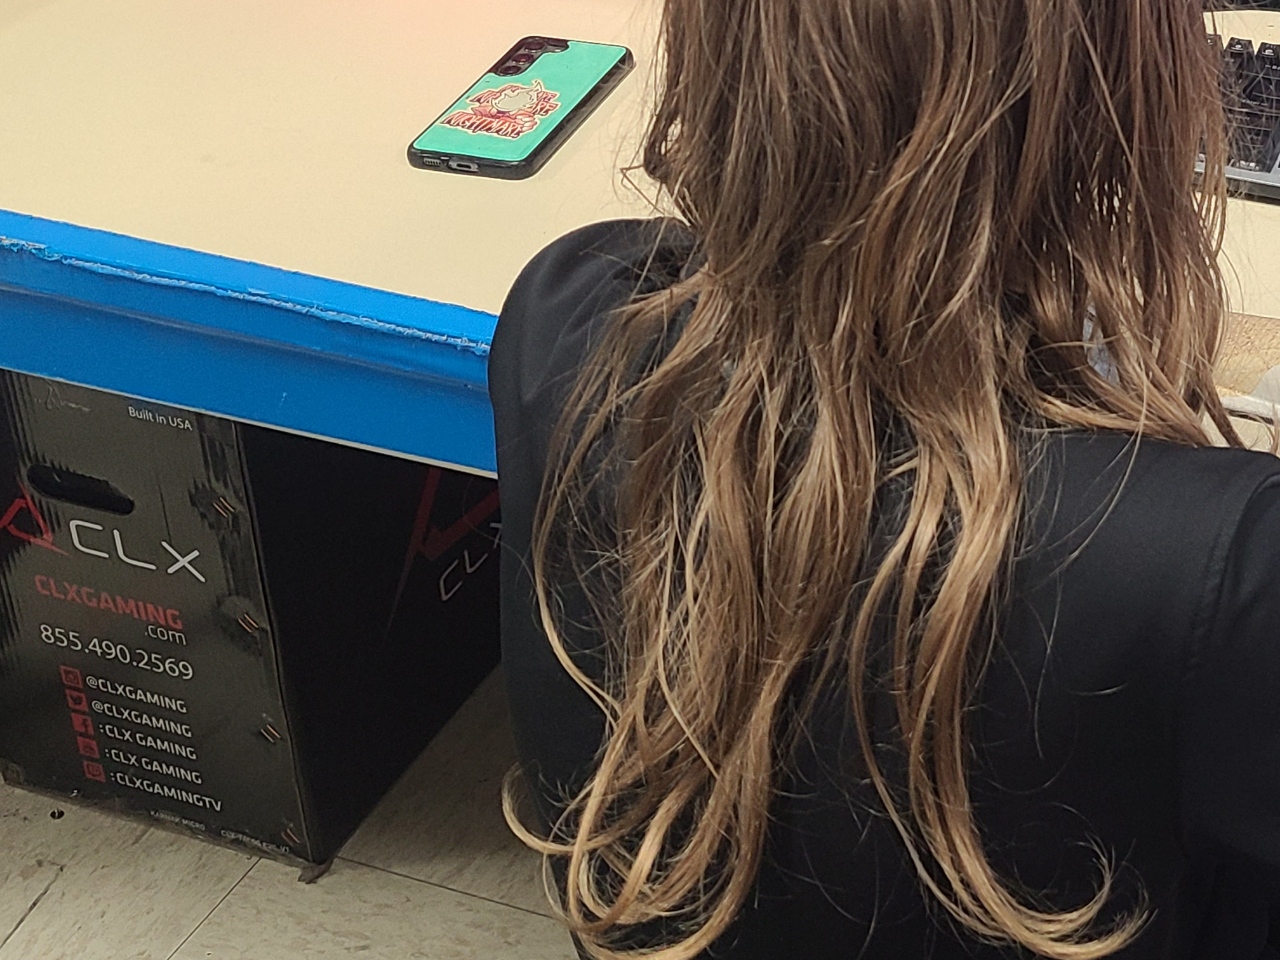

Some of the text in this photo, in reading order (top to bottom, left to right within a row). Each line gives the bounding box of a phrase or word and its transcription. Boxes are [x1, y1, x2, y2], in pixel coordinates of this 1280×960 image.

[442, 111, 523, 138] NIGHTMARE
[128, 406, 192, 431] Built in USA
[69, 519, 206, 583] CLX
[34, 575, 183, 630] CLXGAMING
[40, 624, 193, 680] 855.490.2569
[145, 625, 187, 646] .com
[86, 675, 187, 713] @CLXGAMING
[91, 700, 192, 738] @CLXGAMING
[135, 733, 197, 760] GAMING
[141, 757, 202, 784] GAMING
[110, 772, 222, 812] :CLXGAMINGTV
